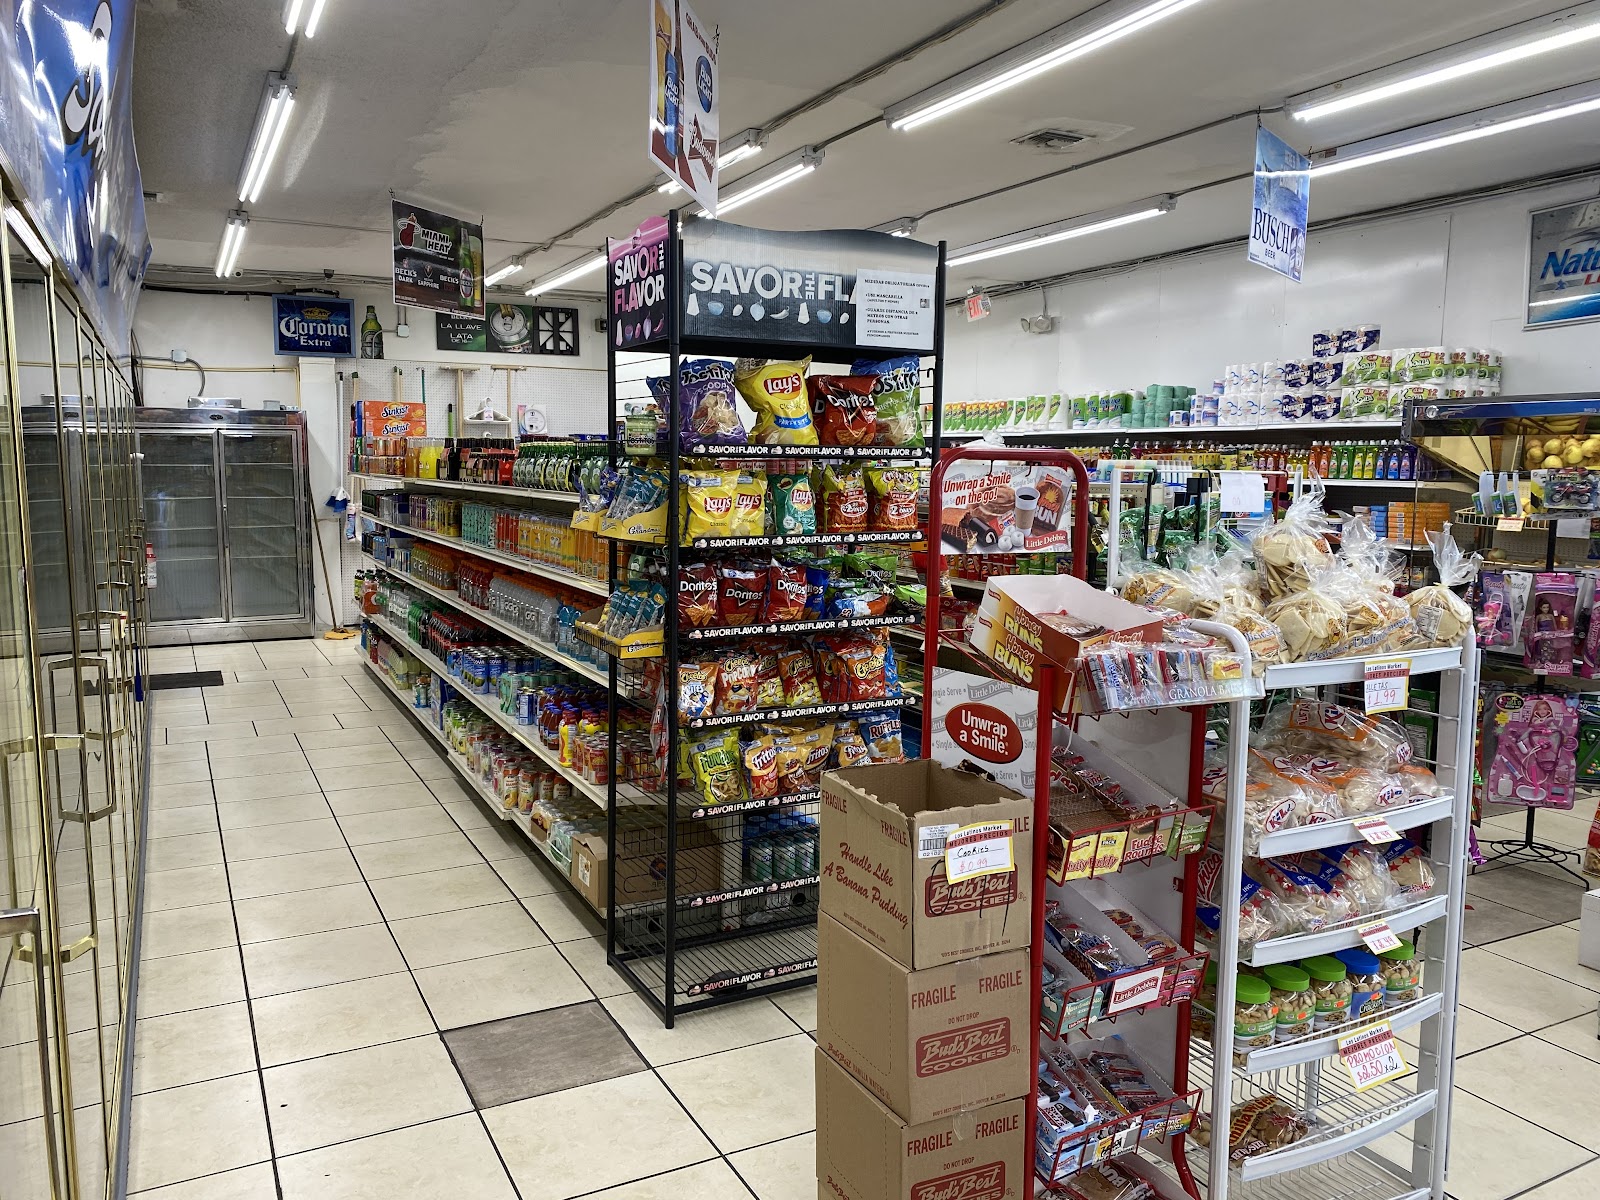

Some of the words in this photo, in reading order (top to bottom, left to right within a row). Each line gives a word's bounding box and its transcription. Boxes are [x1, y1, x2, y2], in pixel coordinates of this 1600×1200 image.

[700, 64, 711, 87] BUD
[667, 76, 678, 95] BUD
[698, 77, 713, 102] LIGHT
[665, 86, 679, 107] LIGHT
[421, 229, 449, 244] MIAMI
[1252, 208, 1291, 254] BUSCH
[427, 240, 450, 254] HEAT
[1265, 248, 1276, 260] BEER
[615, 245, 658, 286] SAVOR
[398, 275, 414, 284] DARK
[691, 261, 803, 299] SAVOR
[805, 272, 816, 300] THE
[614, 274, 665, 315] FLAVOR
[280, 316, 349, 340] Corona
[440, 322, 453, 330] LA
[455, 323, 482, 331] LLAVE
[300, 336, 331, 347] Extra
[767, 375, 800, 394] Lay's
[827, 393, 875, 409] Doritos
[381, 405, 409, 419] Sunkist
[382, 421, 410, 435] Sunkist
[943, 479, 978, 493] Unwrap
[979, 478, 986, 487] a
[986, 473, 1011, 486] Smile
[705, 497, 732, 513] Lay's
[735, 493, 761, 511] Lay's
[792, 489, 812, 504] Lay's
[955, 495, 966, 505] on
[968, 491, 981, 504] the
[982, 488, 998, 506] go!
[1026, 539, 1043, 548] Little
[1043, 534, 1066, 546] Debbie
[680, 580, 718, 592] Doritos
[725, 588, 763, 600] Doritos
[1014, 606, 1042, 637] Honey
[1006, 633, 1035, 665] Honey
[994, 642, 1034, 684] BUNS
[680, 671, 707, 683] Cheetos
[947, 687, 962, 696] Serve
[970, 687, 988, 699] Little
[1168, 685, 1217, 700] GRANOLA
[961, 709, 1008, 740] Unwrap
[936, 740, 952, 751] Single
[960, 730, 968, 742] a
[806, 746, 829, 766] Fritos
[999, 771, 1014, 780] Serve
[822, 789, 848, 814] FRAGILE
[880, 819, 908, 848] FRAGILE
[949, 835, 977, 848] MEJORES
[979, 829, 1009, 841] PRECIOS
[963, 828, 982, 837] Latinos
[983, 824, 1003, 832] Market
[1131, 833, 1164, 851] Fudge
[839, 841, 872, 874] Handle
[873, 862, 894, 887] Like
[823, 861, 834, 877] A
[835, 865, 869, 899] Banana
[871, 886, 909, 930] Pudding
[929, 895, 1015, 915] COOKIES
[911, 985, 957, 1010] FRAGILE
[979, 970, 1023, 994] FRAGILE
[1114, 986, 1133, 1002] Little
[1133, 979, 1158, 995] Debbie
[948, 1017, 956, 1025] DO
[957, 1014, 966, 1023] NOT
[966, 1011, 980, 1021] DROP
[921, 1035, 965, 1067] Bud's
[963, 1024, 1006, 1052] Best
[1343, 1042, 1367, 1054] MEJORES
[1368, 1032, 1391, 1044] PRECIOS
[920, 1047, 1008, 1075] COOKIES
[1154, 1117, 1182, 1130] Cosmic
[907, 1131, 953, 1157] FRAGILE
[975, 1114, 1019, 1140] FRAGILE
[943, 1163, 951, 1171] DO
[951, 1160, 961, 1169] NOT
[961, 1157, 975, 1166] DROP
[959, 1166, 1002, 1195] Best
